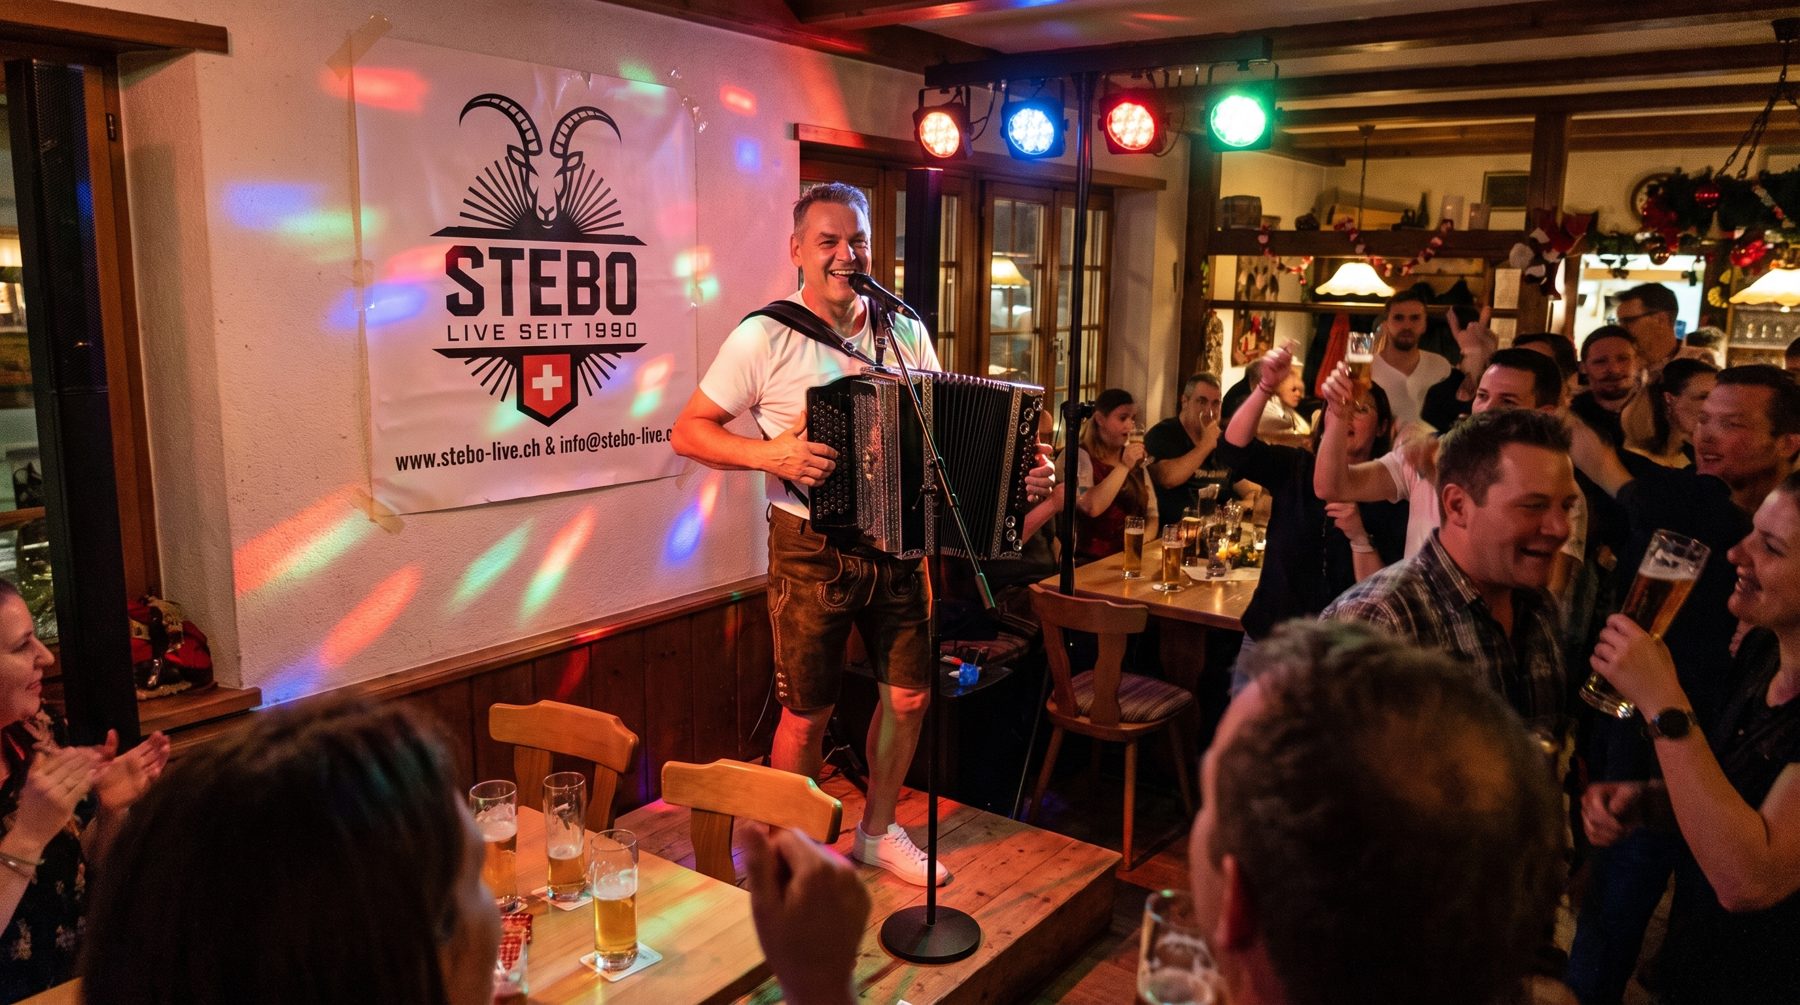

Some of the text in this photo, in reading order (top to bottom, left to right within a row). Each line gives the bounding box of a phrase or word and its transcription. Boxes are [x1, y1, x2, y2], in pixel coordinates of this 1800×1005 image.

[445, 245, 638, 317] STEBO
[447, 321, 637, 342] LIVE SEIT 1990
[395, 424, 674, 472] www.stebo-live.ch & info@stebo-live.c
